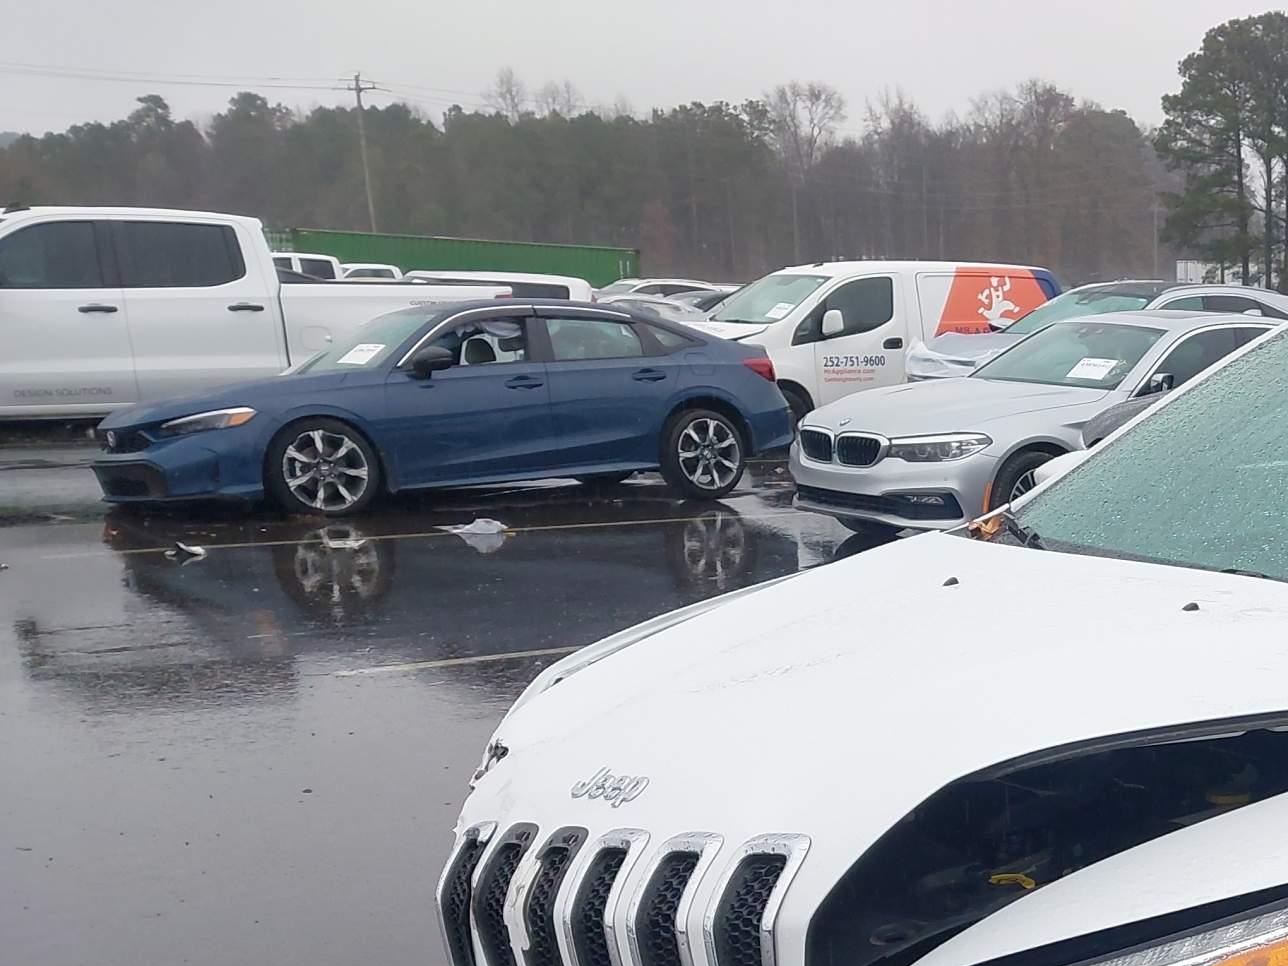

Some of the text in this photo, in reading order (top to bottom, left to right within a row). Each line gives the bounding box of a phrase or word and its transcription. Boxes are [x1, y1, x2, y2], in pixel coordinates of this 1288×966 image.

[823, 355, 886, 368] 252-751-9600
[13, 386, 113, 398] DESIGN SOLUTIONS
[570, 765, 650, 808] Jeep
